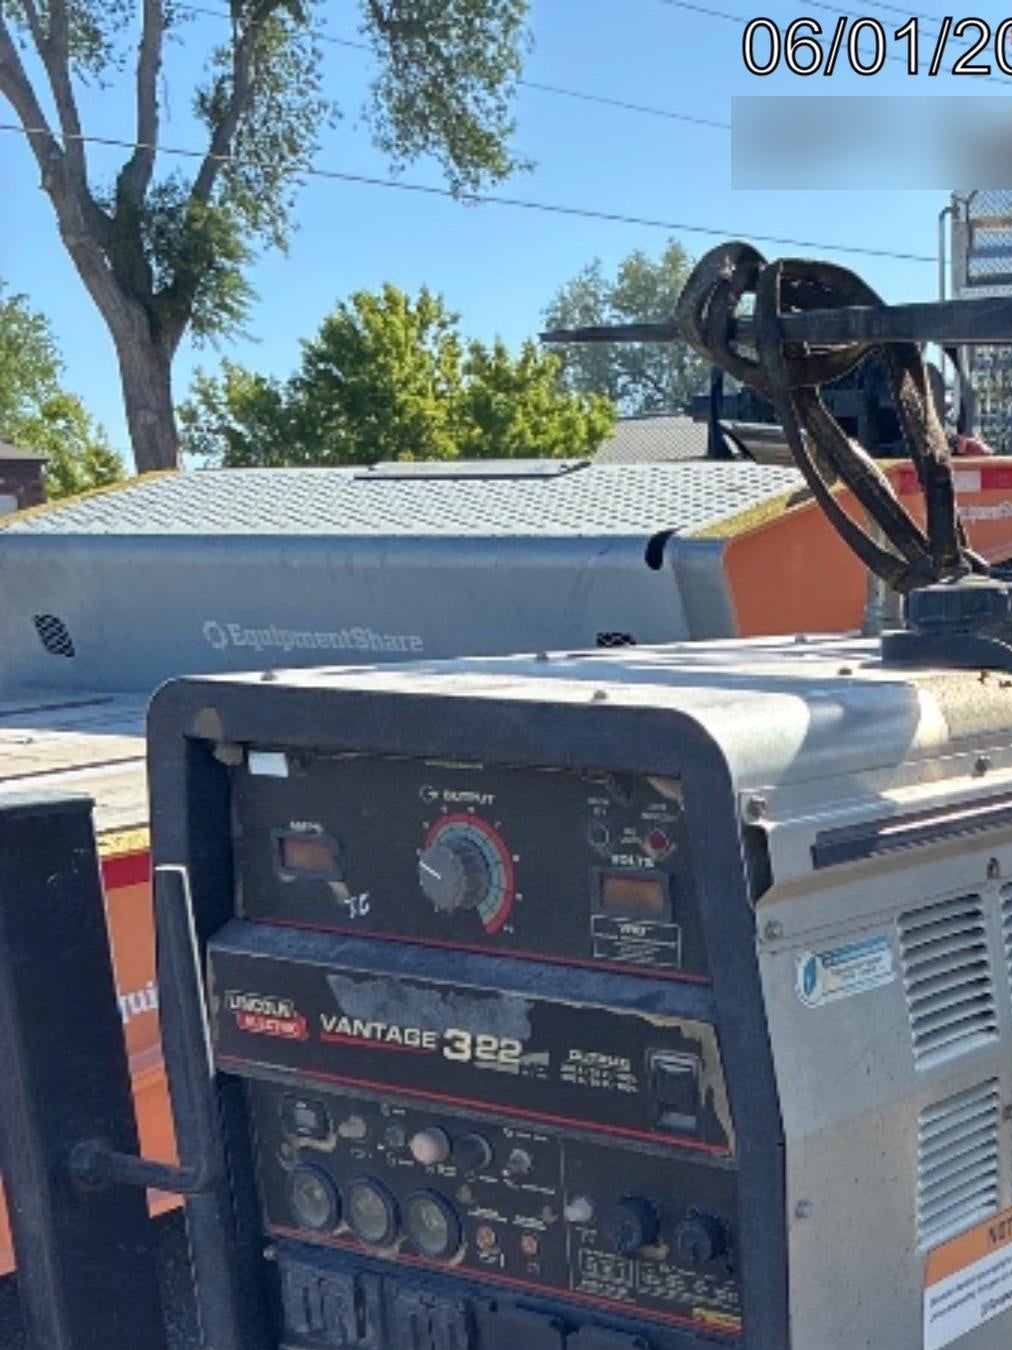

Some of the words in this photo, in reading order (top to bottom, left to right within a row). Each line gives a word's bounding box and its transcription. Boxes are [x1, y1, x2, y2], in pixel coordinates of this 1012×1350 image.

[226, 623, 424, 652] EquipmentShare
[320, 1013, 438, 1050] VANTAGE
[443, 1027, 524, 1065] 322
